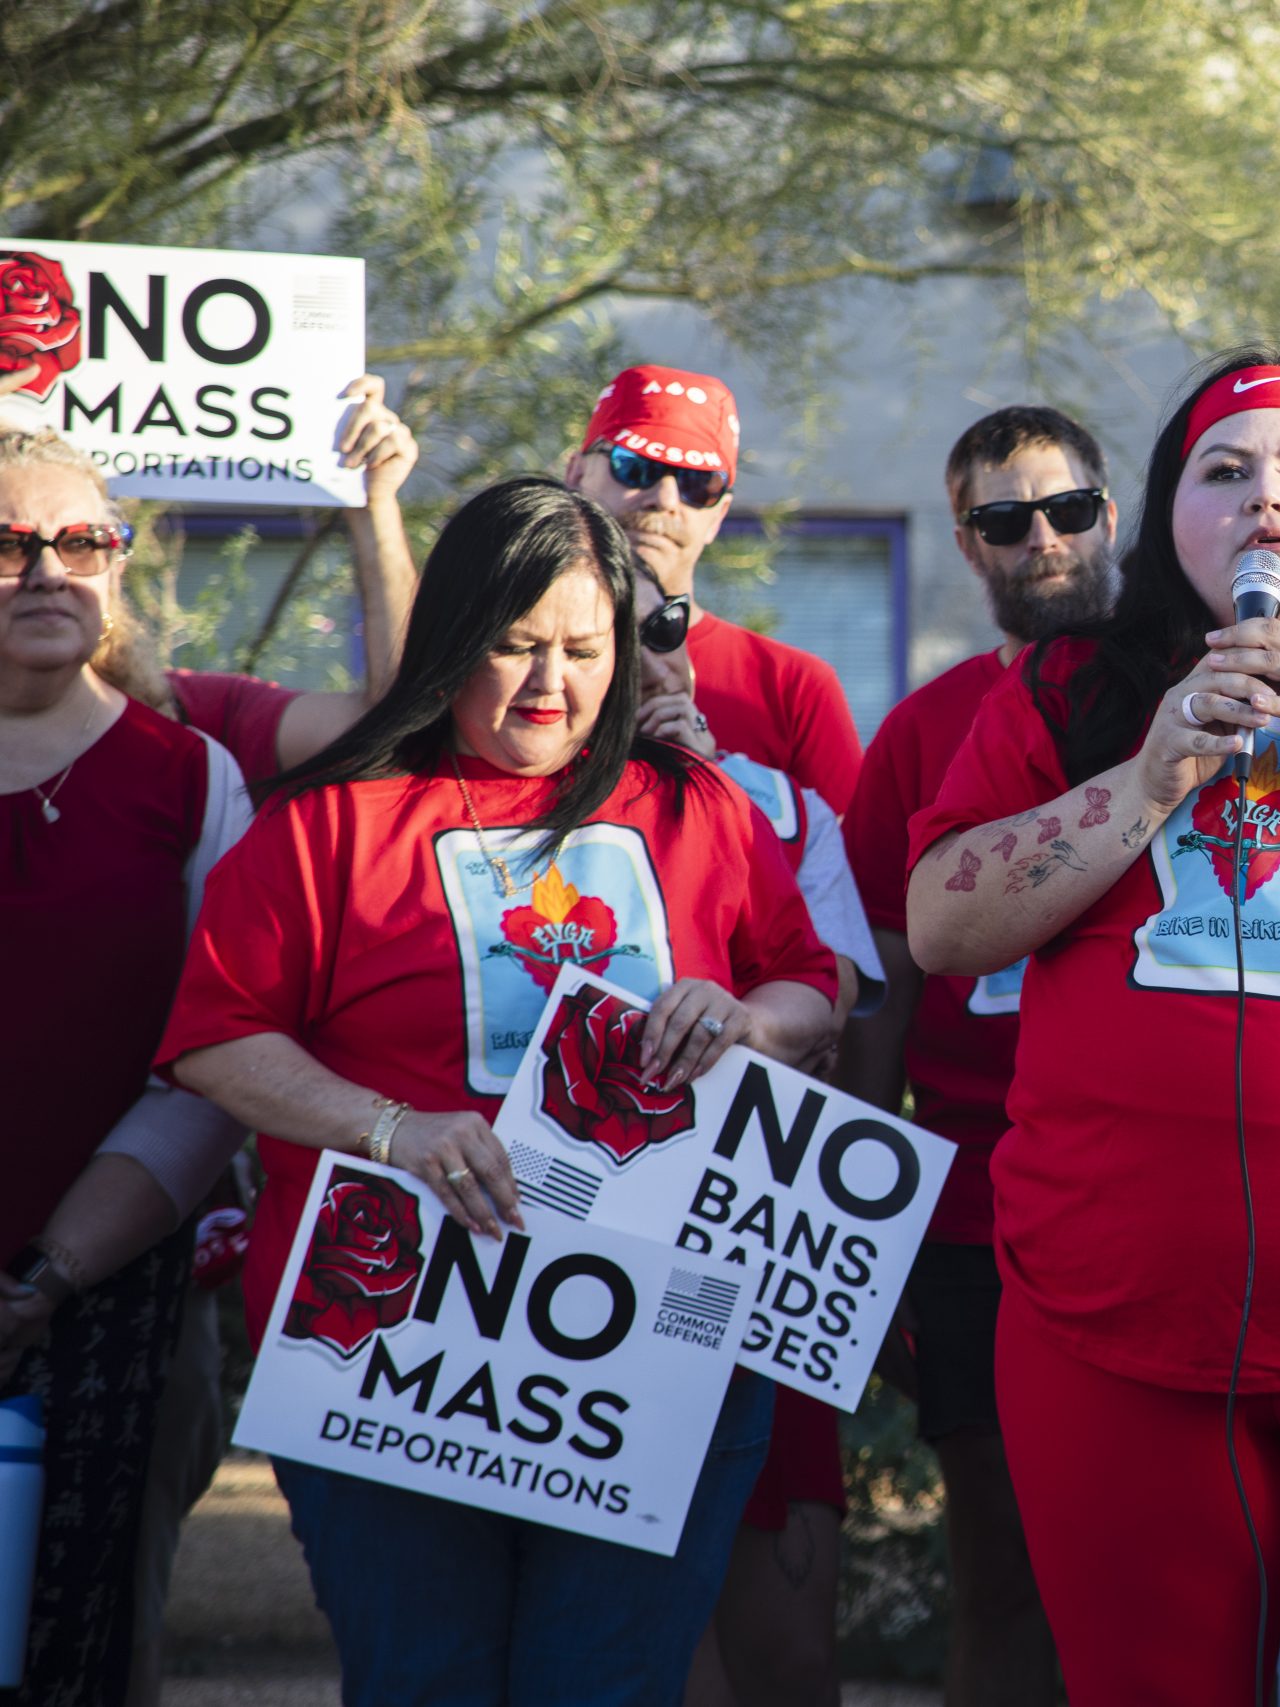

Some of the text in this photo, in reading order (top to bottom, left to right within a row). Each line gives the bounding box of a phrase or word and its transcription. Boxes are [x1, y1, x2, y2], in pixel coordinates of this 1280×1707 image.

[88, 271, 271, 365] NO
[63, 381, 293, 441] MASS
[613, 428, 723, 468] TUCSON
[90, 450, 314, 483] PORTATIONS
[712, 1060, 921, 1221] NO
[688, 1167, 878, 1298] BANS.
[412, 1213, 637, 1362] NO
[657, 1308, 727, 1337] COMMON
[652, 1320, 723, 1351] DEFENSE
[741, 1311, 841, 1391] GES.
[358, 1333, 631, 1461] MASS
[318, 1410, 632, 1515] DEPORTATIONS
